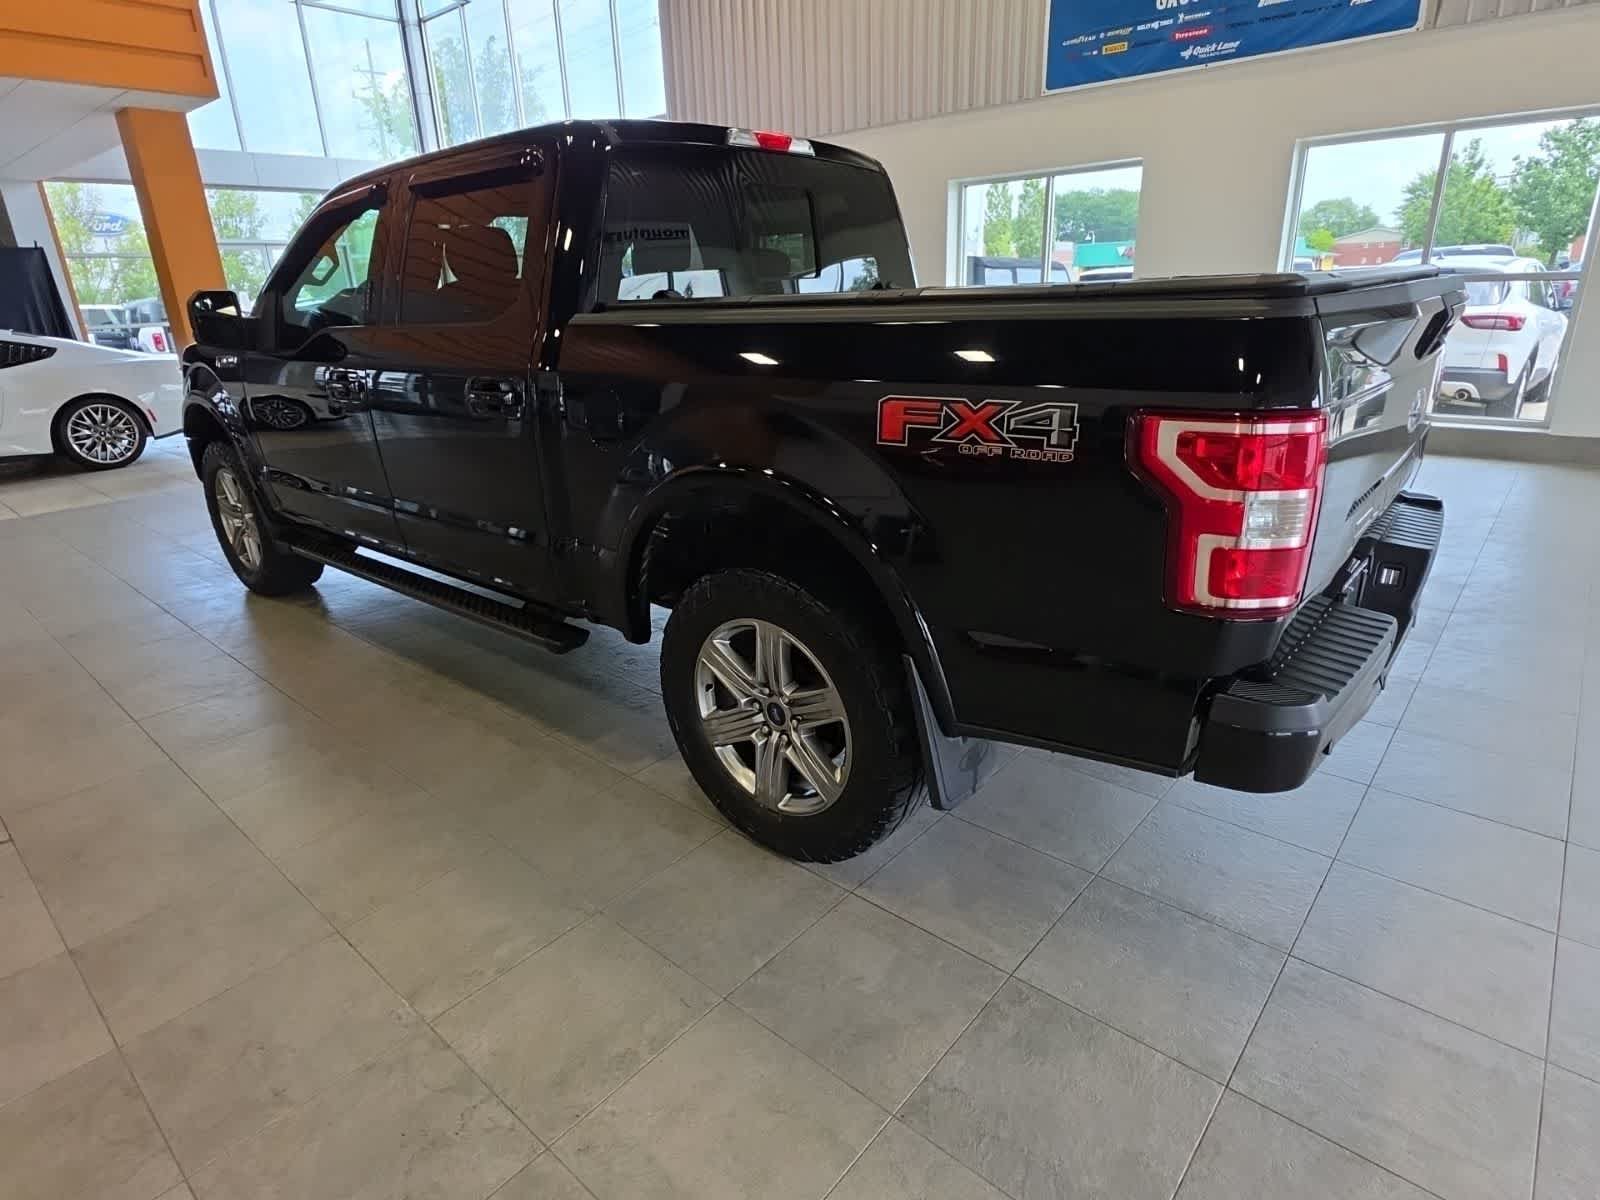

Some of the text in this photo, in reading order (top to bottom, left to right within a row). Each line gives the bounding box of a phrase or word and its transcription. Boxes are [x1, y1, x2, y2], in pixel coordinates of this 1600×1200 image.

[1193, 43, 1217, 56] Quick
[876, 395, 1080, 452] FX4
[958, 444, 1074, 463] OFF ROAD
